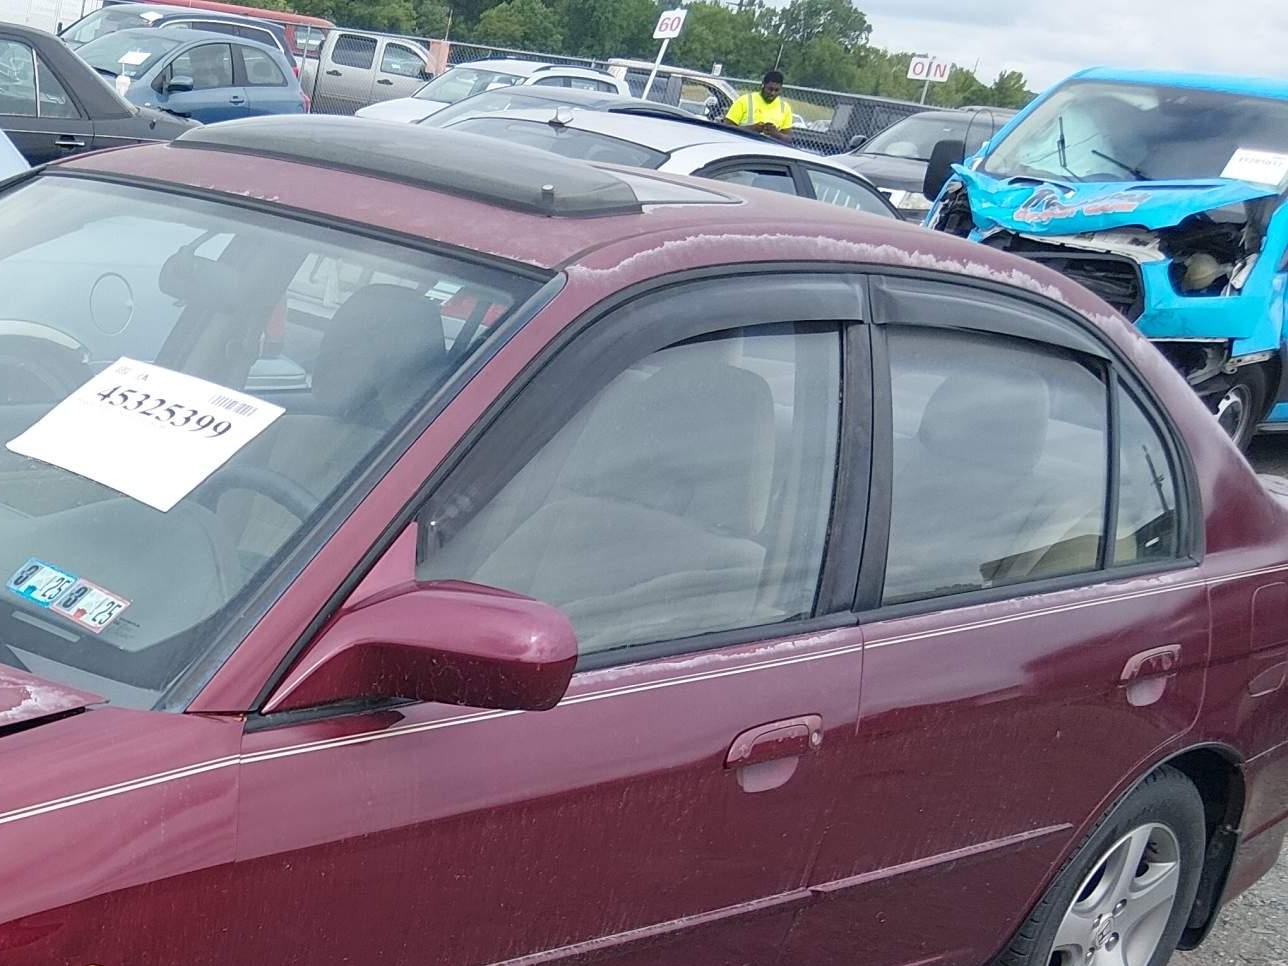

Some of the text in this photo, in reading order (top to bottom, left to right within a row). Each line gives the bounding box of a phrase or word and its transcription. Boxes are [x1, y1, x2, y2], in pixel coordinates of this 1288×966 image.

[658, 16, 682, 33] 60
[96, 385, 232, 439] 45325399
[41, 576, 72, 601] 25
[91, 600, 122, 626] 25
